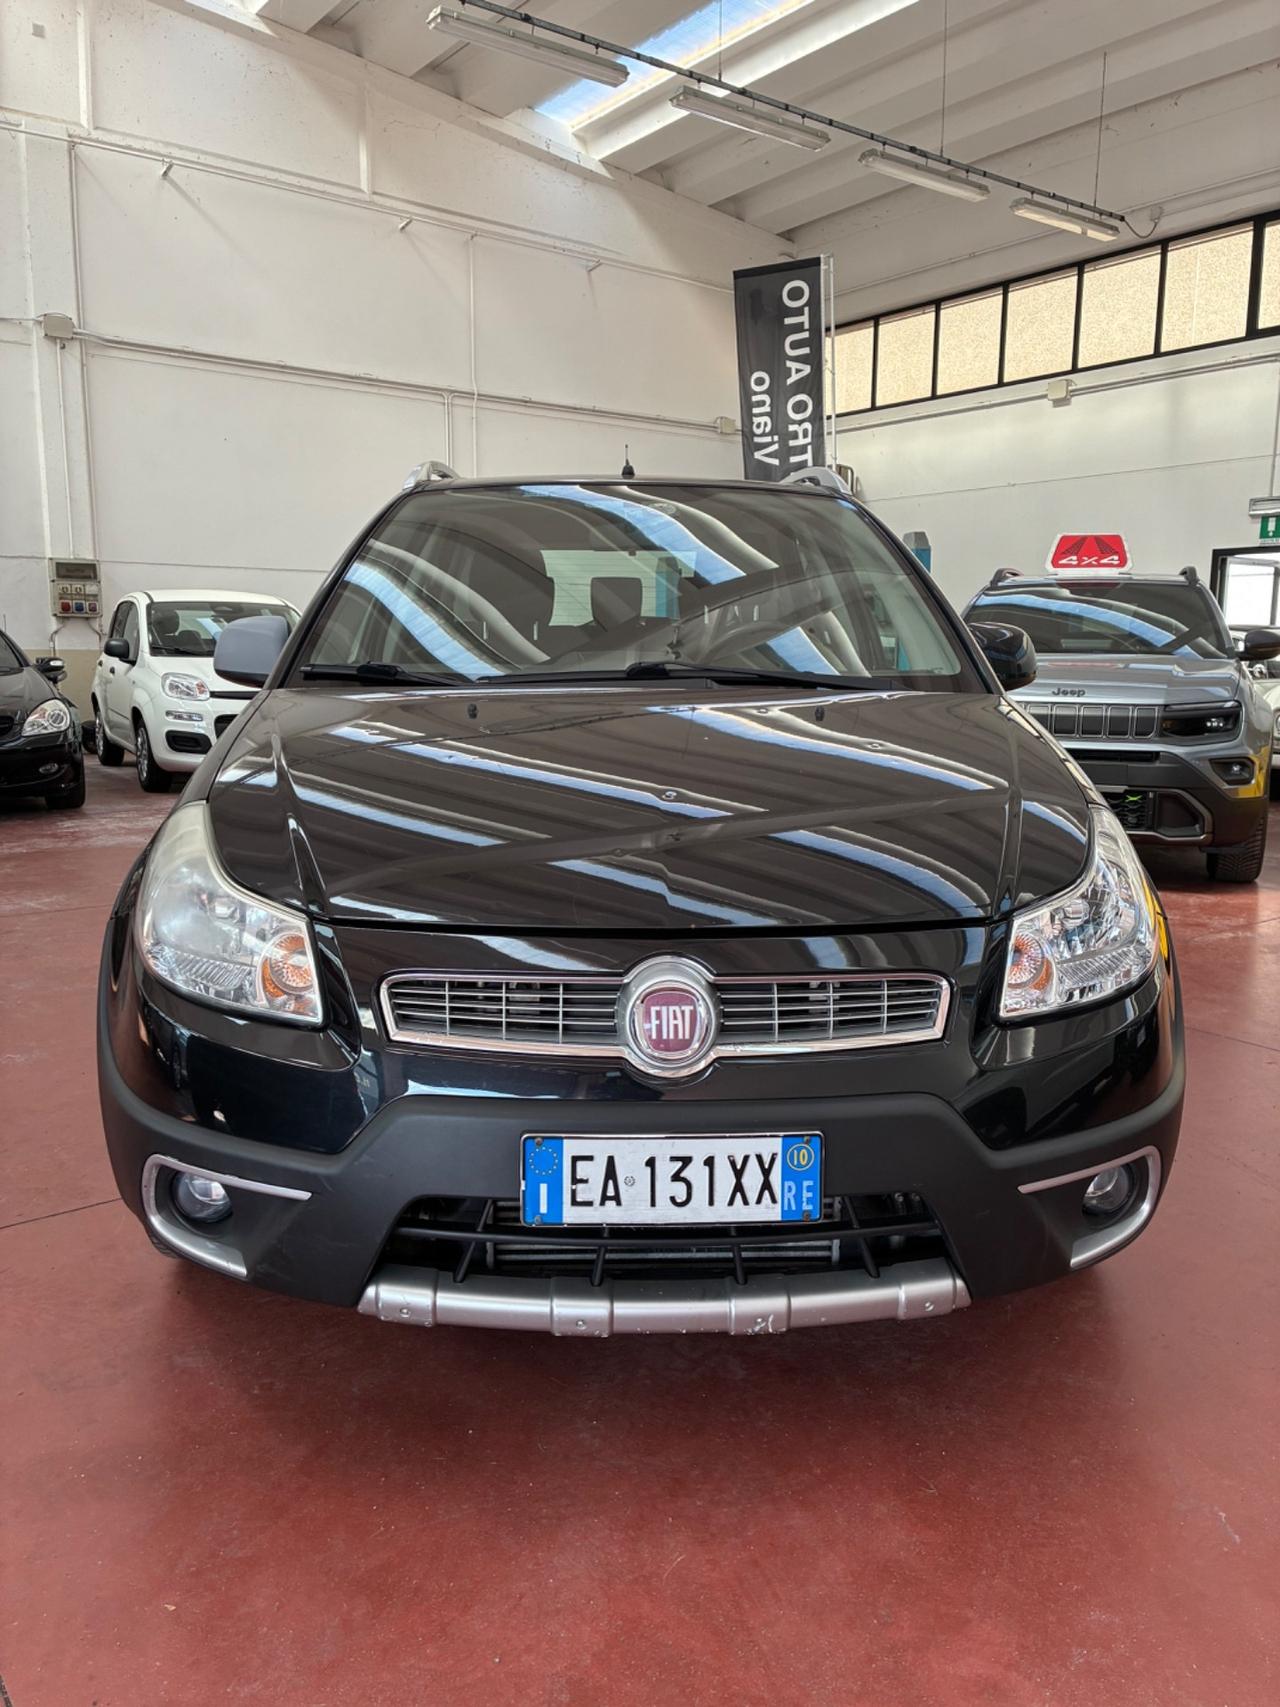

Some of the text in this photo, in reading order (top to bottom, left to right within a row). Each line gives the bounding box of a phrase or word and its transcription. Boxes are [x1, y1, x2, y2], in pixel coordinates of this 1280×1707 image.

[1051, 687, 1086, 698] Jeep
[650, 1005, 694, 1040] FIAT
[793, 1149, 808, 1166] 10
[783, 1180, 814, 1210] RE
